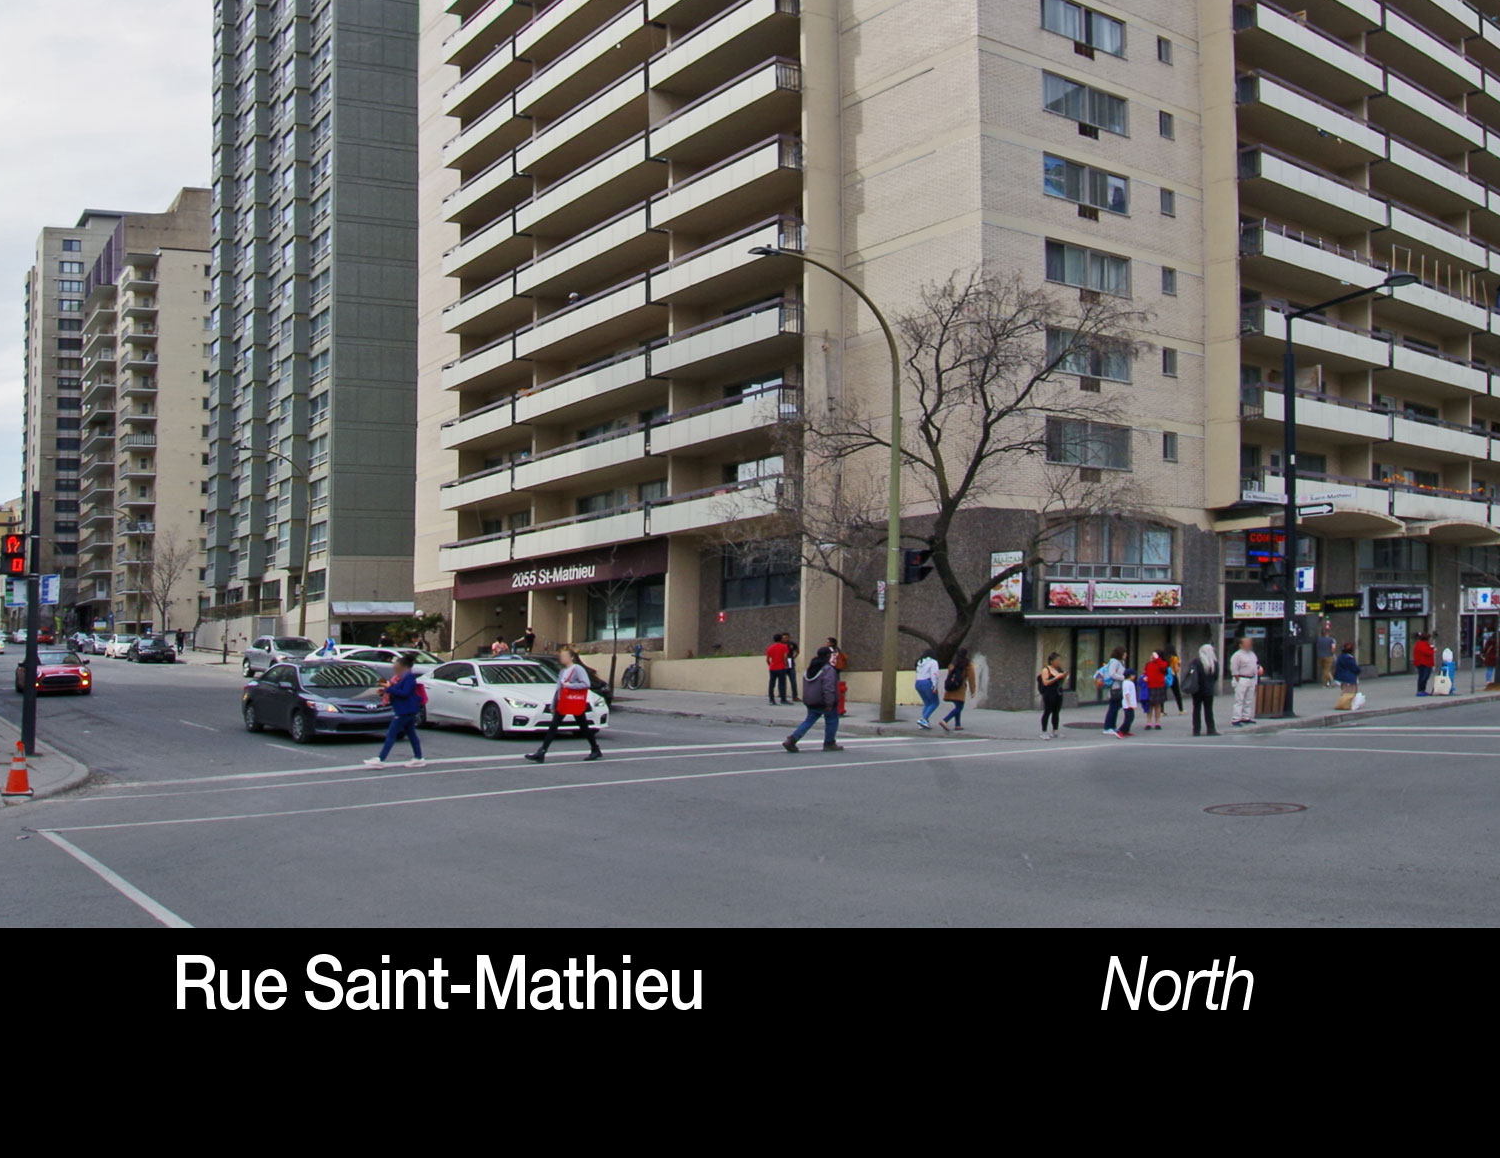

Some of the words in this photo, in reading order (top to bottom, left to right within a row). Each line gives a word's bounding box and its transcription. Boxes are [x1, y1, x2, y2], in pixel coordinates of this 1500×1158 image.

[512, 570, 536, 588] 2055
[538, 563, 596, 585] St-Mathieu
[1235, 602, 1251, 611] FedEx
